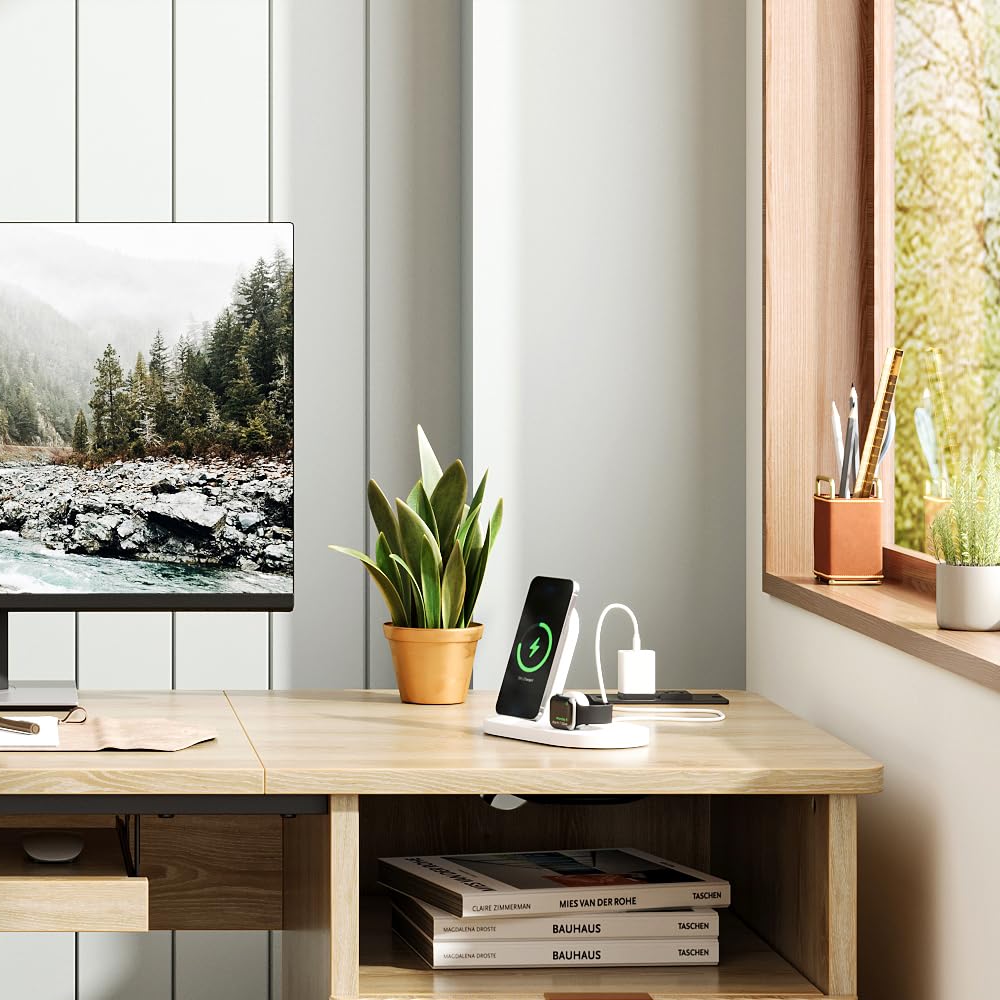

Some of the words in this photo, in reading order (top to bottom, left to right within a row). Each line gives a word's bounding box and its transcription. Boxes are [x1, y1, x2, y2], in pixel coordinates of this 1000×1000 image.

[692, 891, 722, 900] TASCHEN
[559, 899, 578, 908] MIES
[580, 899, 596, 907] VAN
[597, 898, 613, 906] DER
[614, 896, 637, 906] ROHE
[472, 904, 492, 912] CLAIRE
[493, 903, 531, 911] ZIMMERMAN
[552, 923, 601, 934] BAUHAUS
[678, 922, 709, 930] TASCHEN
[552, 950, 601, 960] BAUHAUS
[678, 949, 709, 957] TASCHEN
